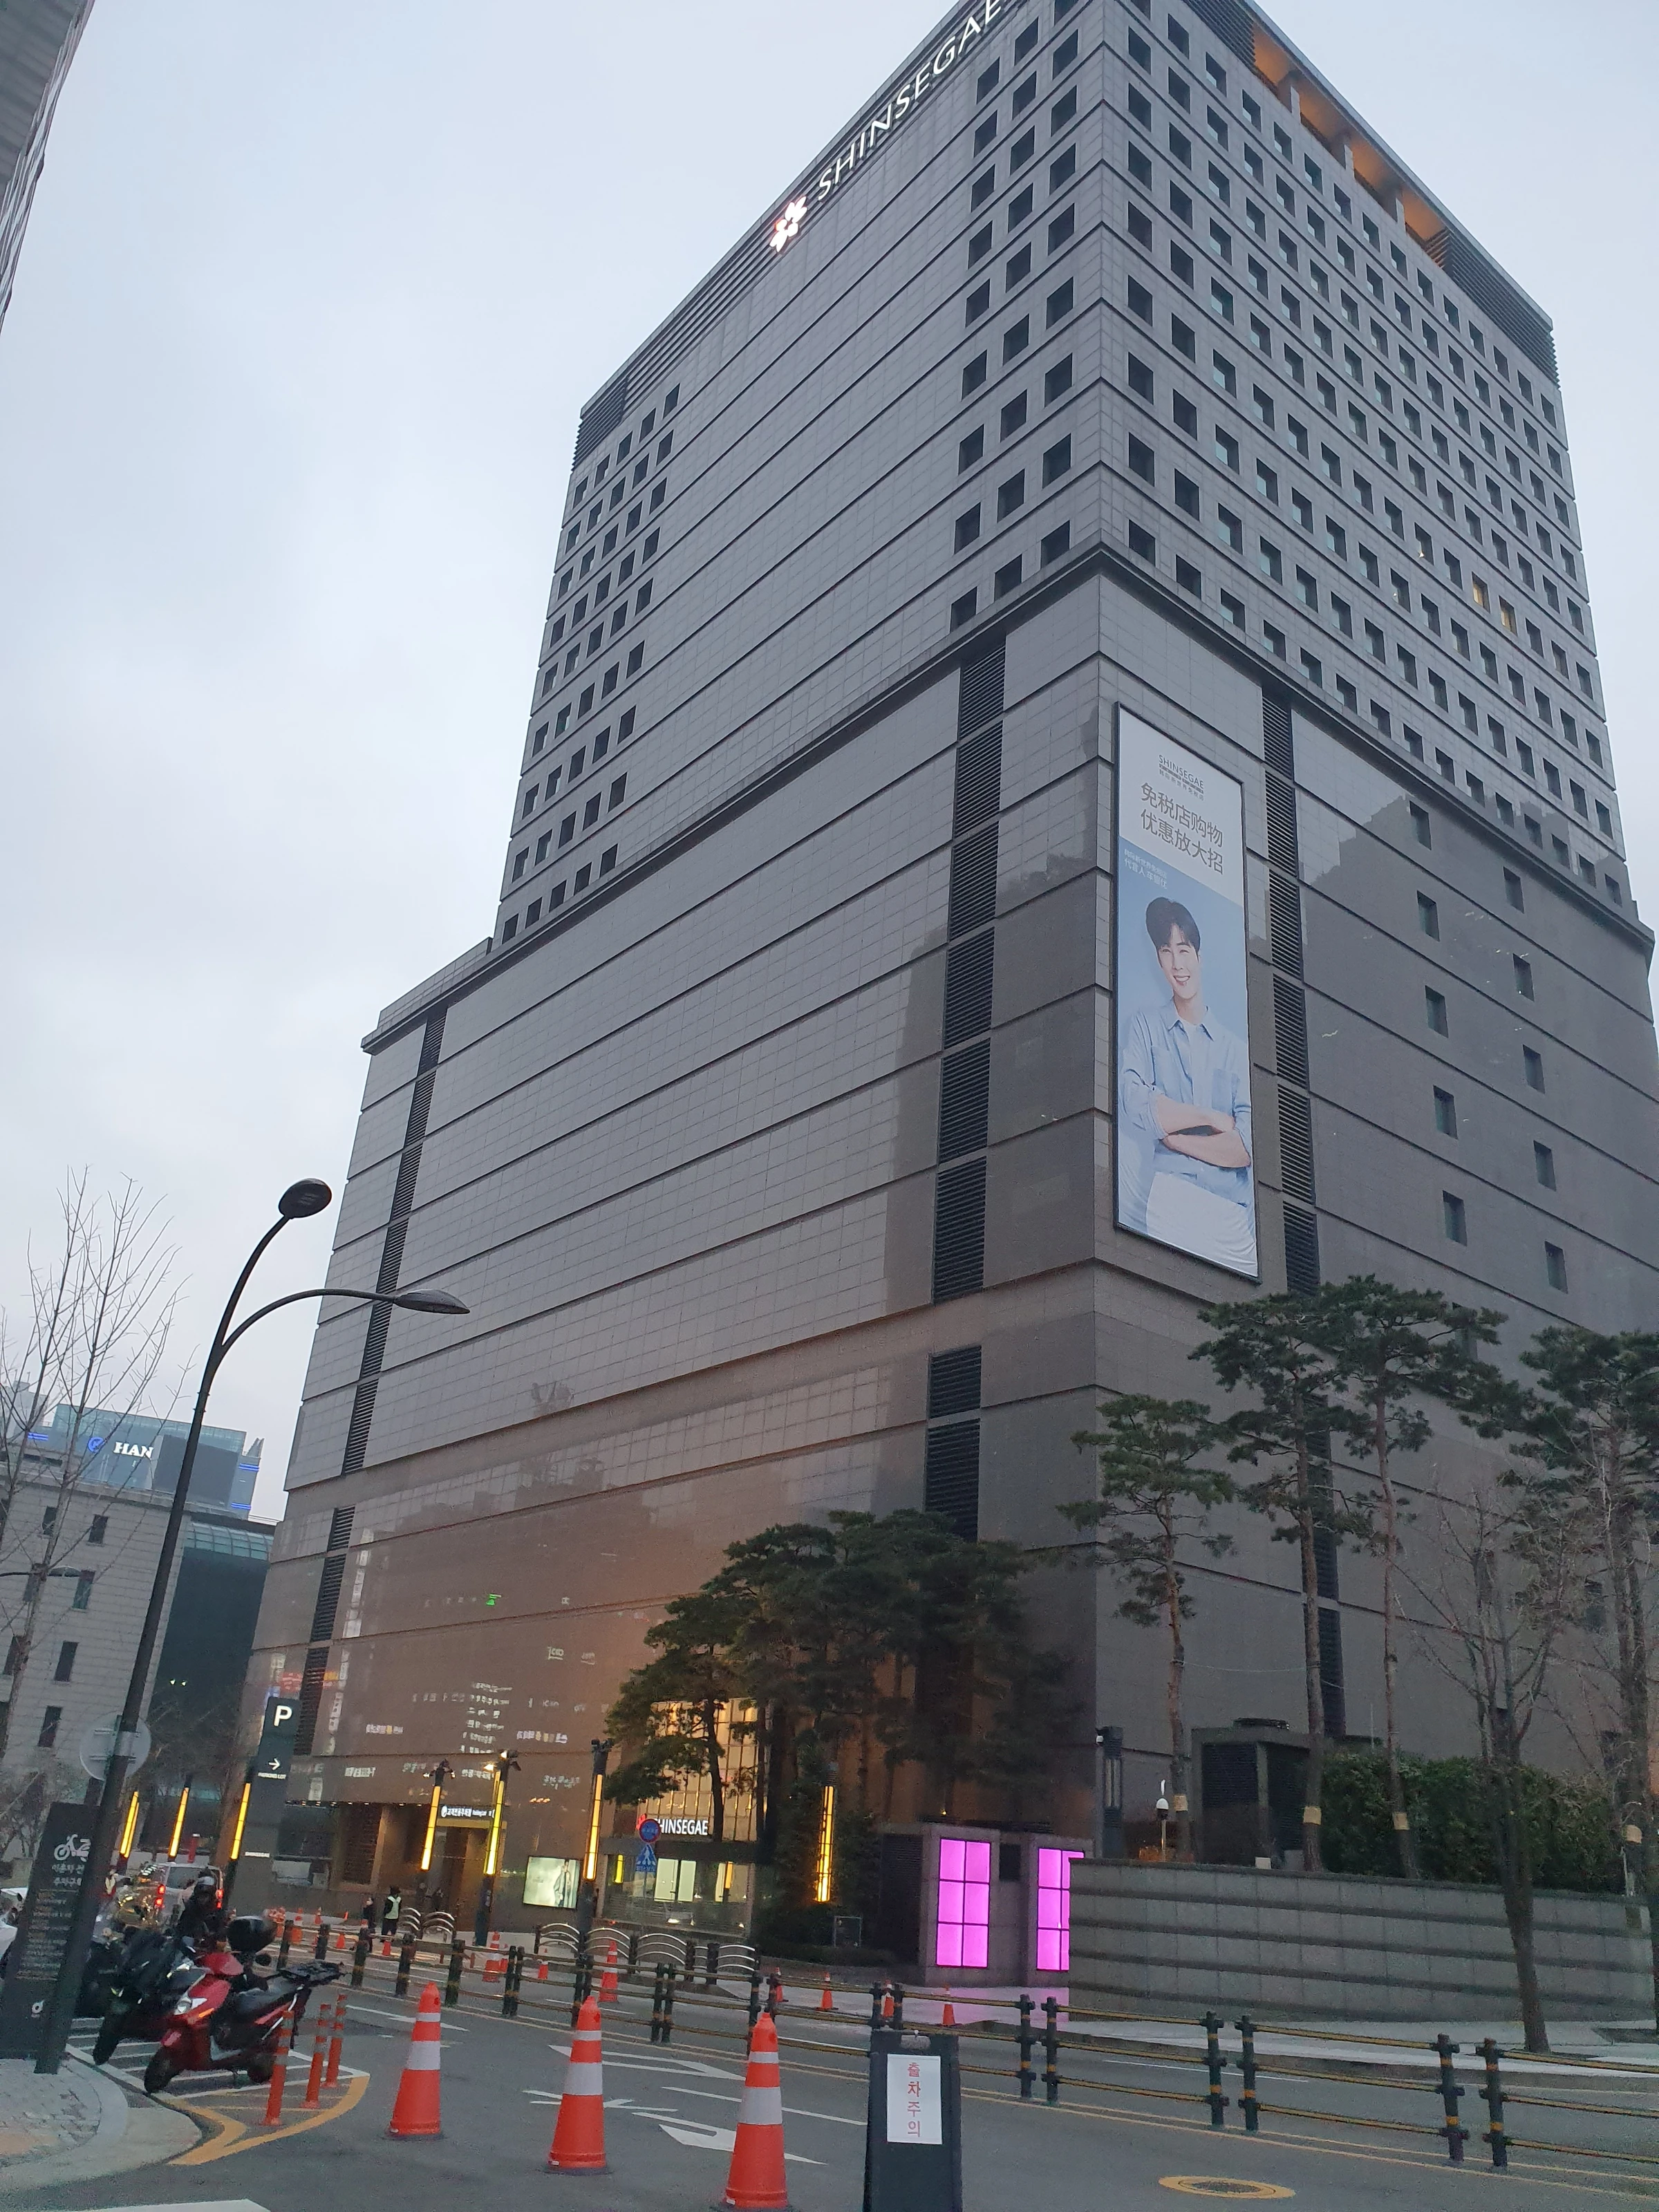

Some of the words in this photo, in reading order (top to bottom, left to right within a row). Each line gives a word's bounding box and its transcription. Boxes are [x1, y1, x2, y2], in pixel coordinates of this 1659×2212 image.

[818, 0, 1002, 200] SHINSEGAE
[1159, 754, 1204, 789] SHINSEGAE
[1141, 782, 1223, 847] 免税店购物
[1141, 809, 1223, 875] 优惠放大招
[113, 1441, 154, 1461] HAN
[274, 1705, 292, 1727] P
[654, 1818, 709, 1835] HINSEGAE
